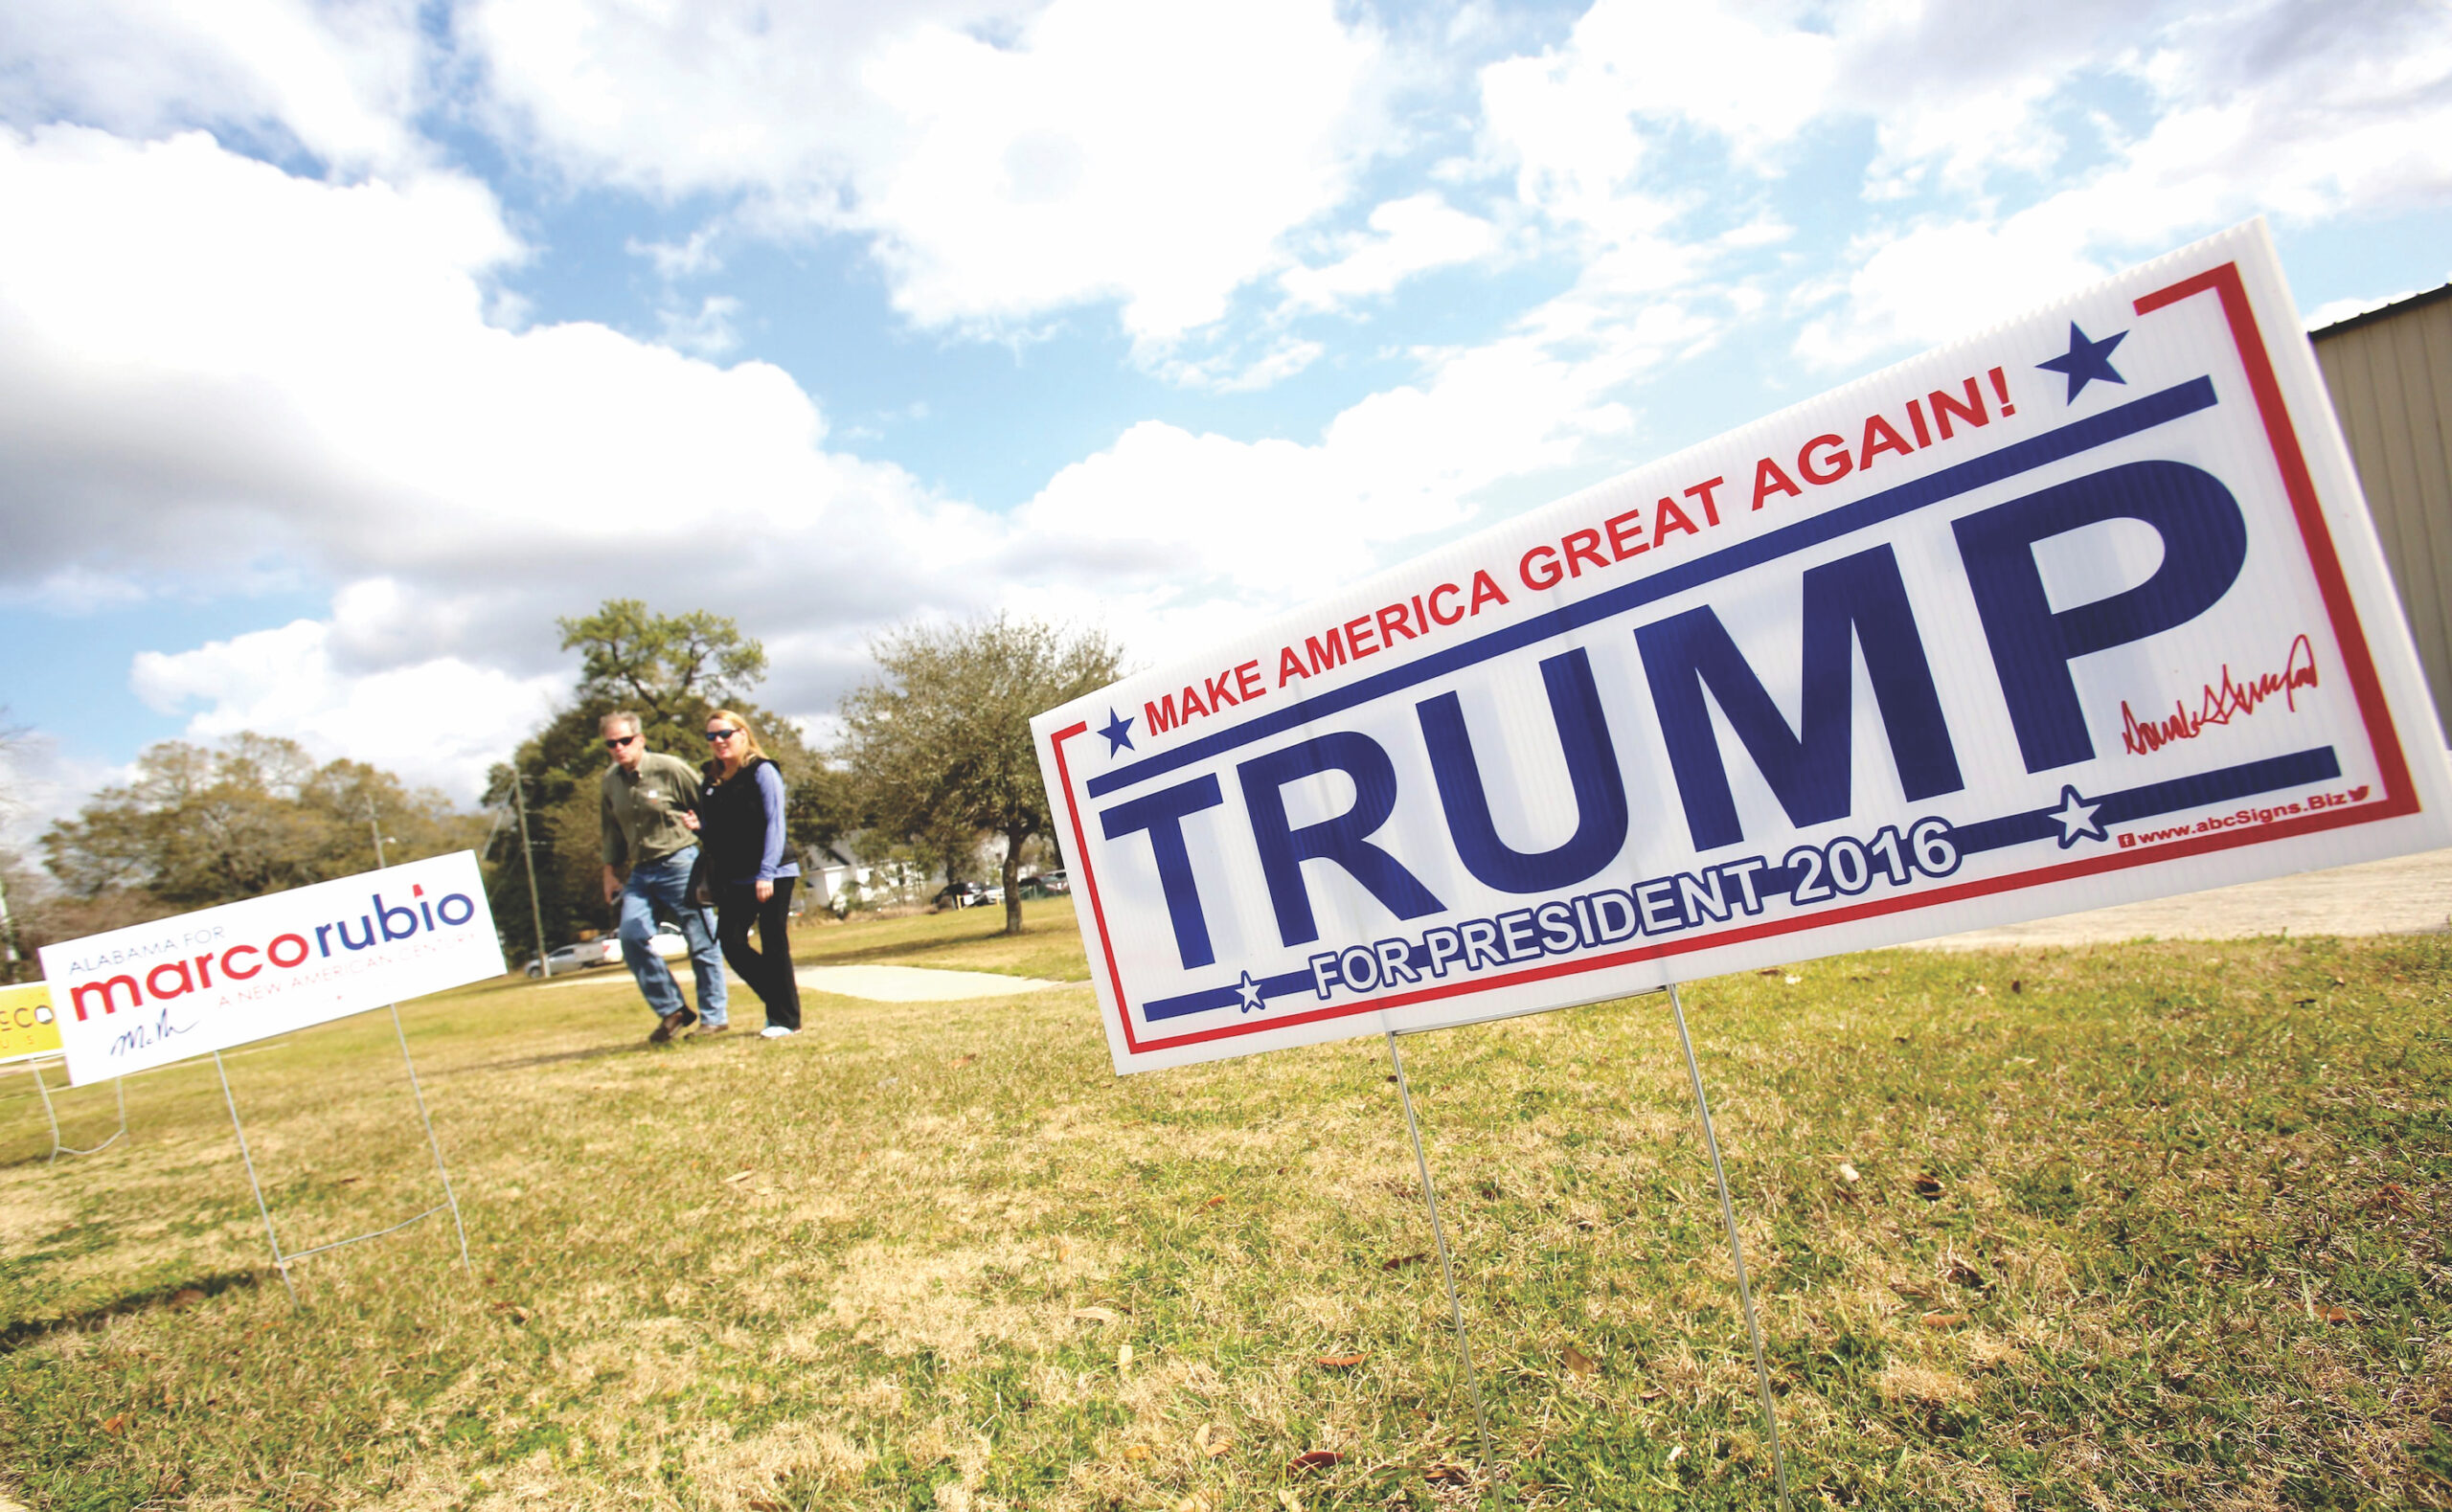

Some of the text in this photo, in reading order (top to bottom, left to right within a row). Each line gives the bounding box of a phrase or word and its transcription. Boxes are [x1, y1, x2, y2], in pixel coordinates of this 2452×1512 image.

[1144, 366, 2017, 736] MAKE AMERICA GREAT AGAIN!
[1099, 459, 2248, 971] TRUMP
[2137, 792, 2349, 845] www.abcSigns.Biz
[68, 925, 226, 975] ALABAMA FOR
[238, 982, 282, 1002] NEW
[290, 955, 393, 990] AMERICAN
[398, 933, 477, 961] CENTRY
[1310, 817, 1962, 1000] FOR PRESIDENT 2016
